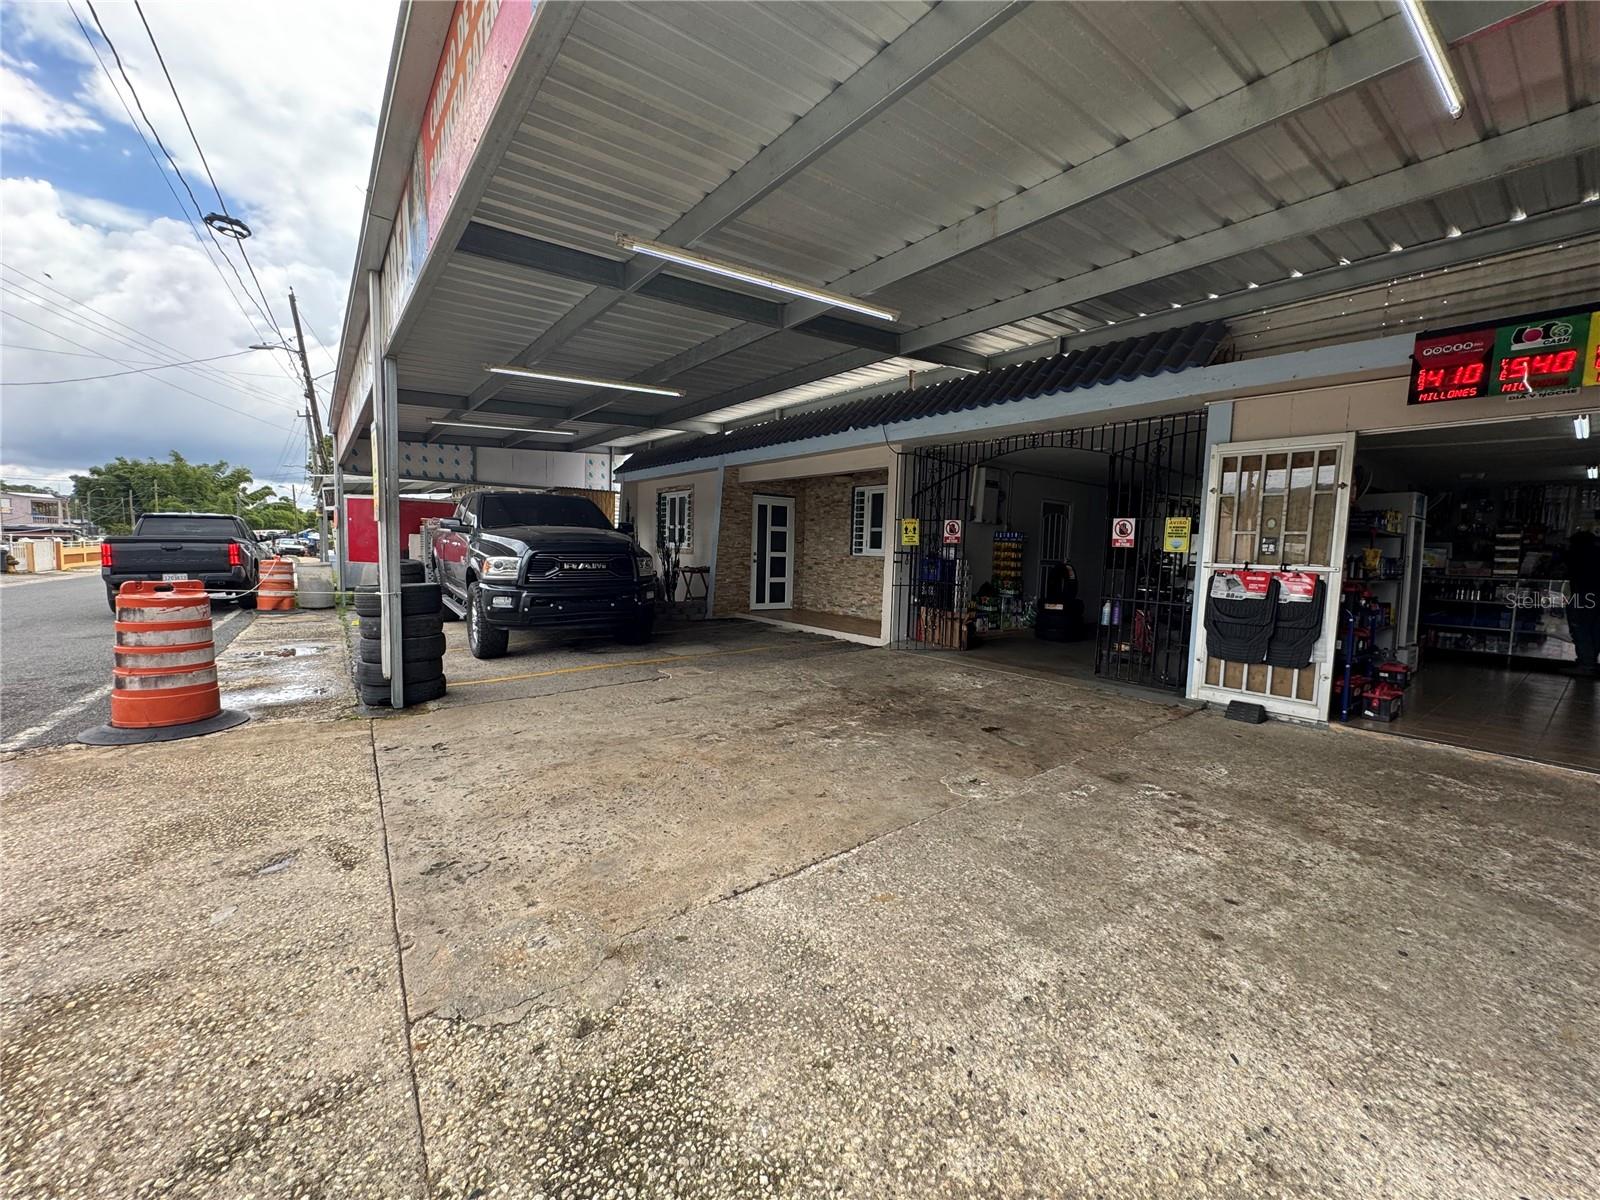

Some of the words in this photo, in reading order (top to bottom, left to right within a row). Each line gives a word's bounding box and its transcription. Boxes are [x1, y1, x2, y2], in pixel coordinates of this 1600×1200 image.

[466, 0, 501, 95] BATER
[430, 40, 456, 140] CAMBIO
[1543, 336, 1570, 345] CASH
[1423, 342, 1473, 356] POWER
[1508, 350, 1577, 379] 540
[1427, 363, 1484, 387] 410
[1419, 387, 1477, 401] MILLONES
[1538, 389, 1577, 398] NOCHE
[132, 557, 213, 565] TACOMA
